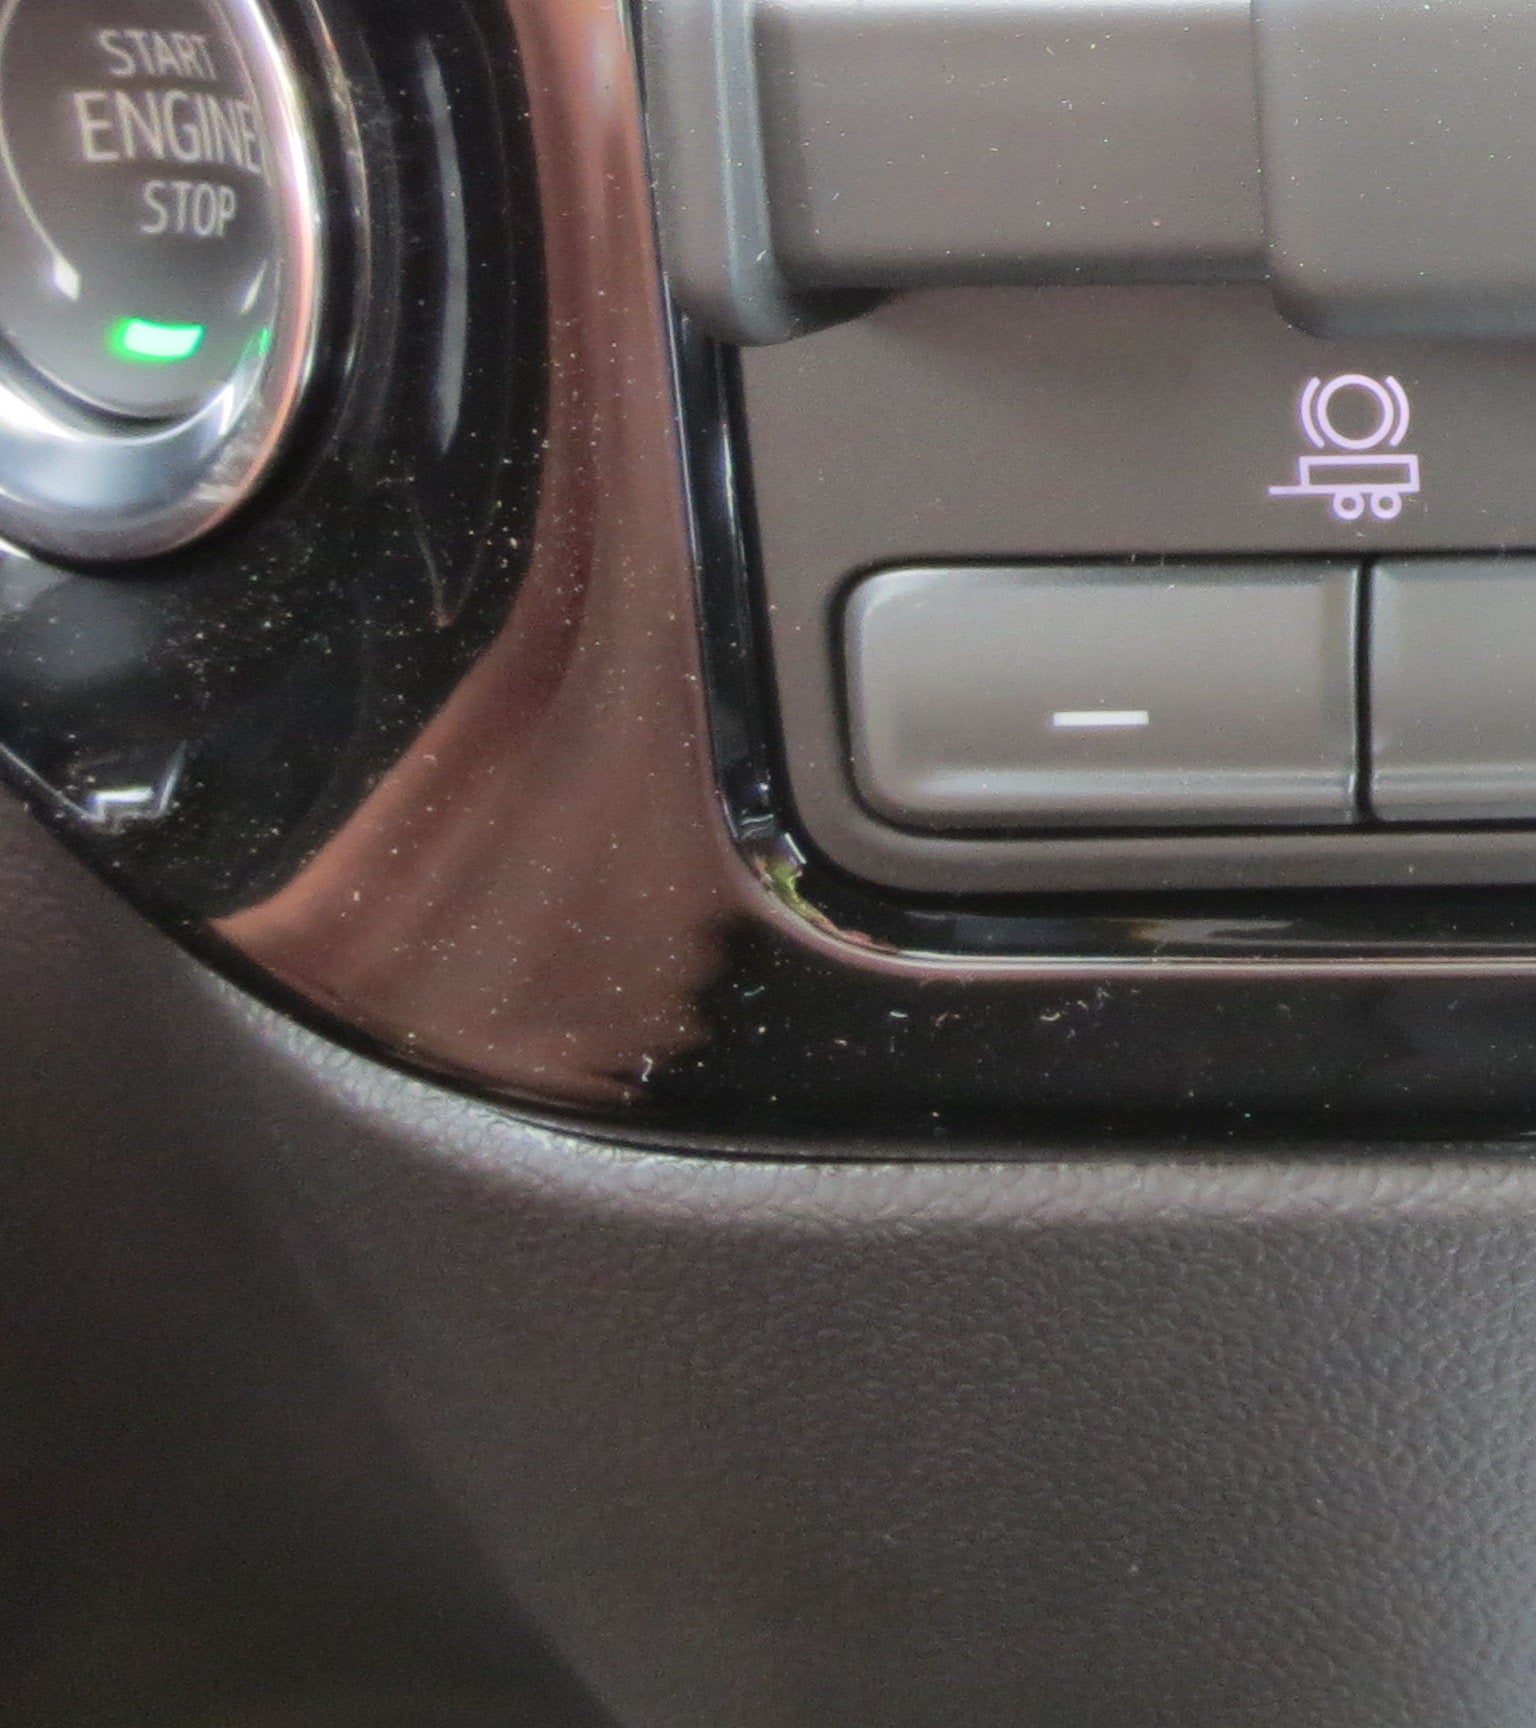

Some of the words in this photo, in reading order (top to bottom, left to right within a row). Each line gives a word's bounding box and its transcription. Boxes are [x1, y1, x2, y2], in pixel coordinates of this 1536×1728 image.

[97, 29, 217, 81] START
[73, 89, 266, 174] ENGINE
[140, 179, 237, 238] STOP
